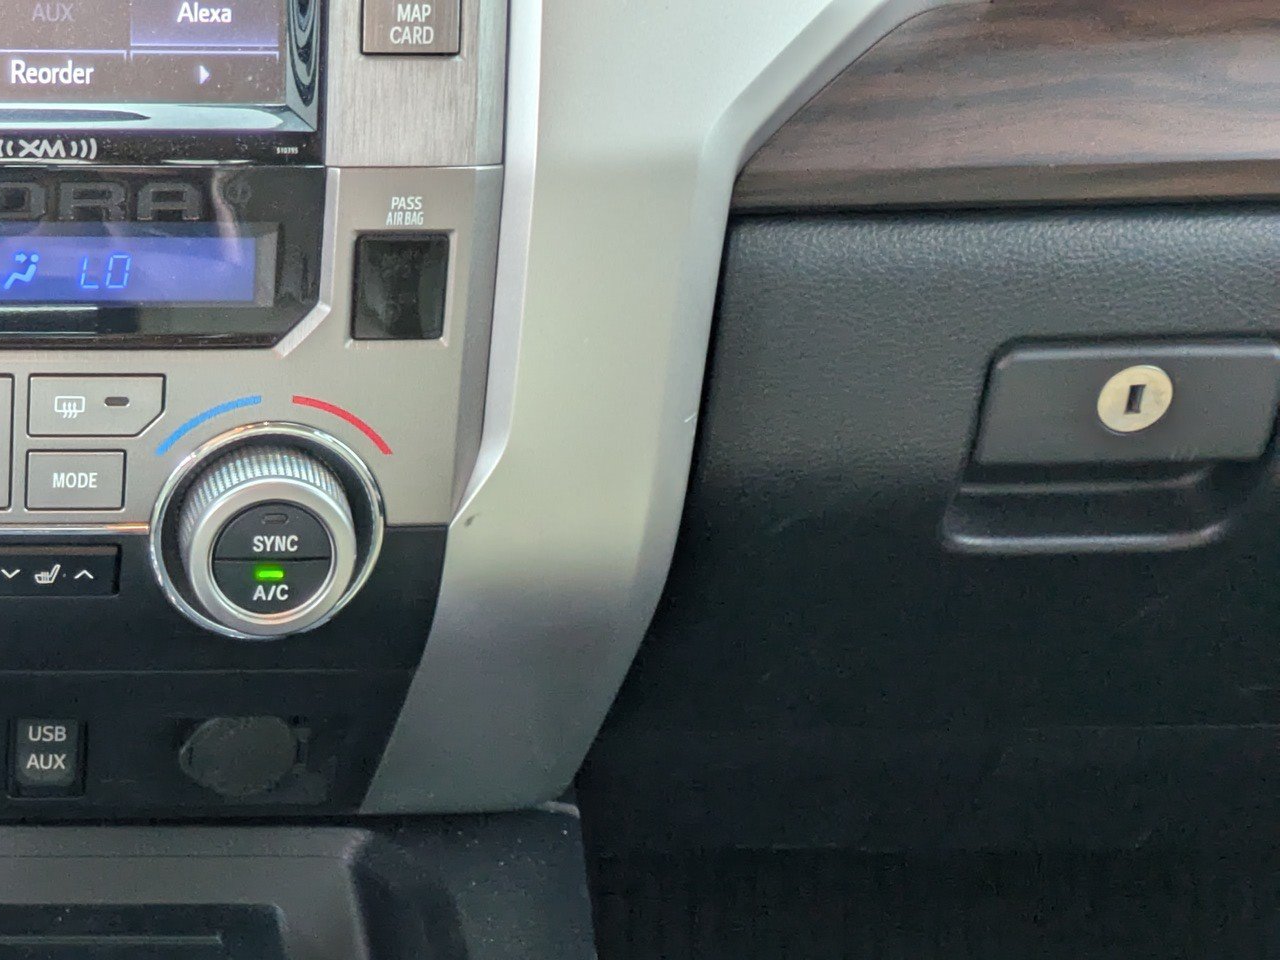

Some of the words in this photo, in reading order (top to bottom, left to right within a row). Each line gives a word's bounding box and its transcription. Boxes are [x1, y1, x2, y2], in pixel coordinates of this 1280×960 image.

[32, 3, 74, 22] AUX
[177, 2, 232, 23] Alexa
[397, 4, 431, 22] MAP
[390, 27, 434, 44] CARD
[10, 60, 94, 85] Reorder
[391, 197, 422, 210] PASS
[52, 473, 98, 488] MODE
[253, 536, 299, 552] SYNC
[253, 585, 289, 601] A/C
[28, 725, 67, 742] USB
[26, 754, 67, 770] AUX
